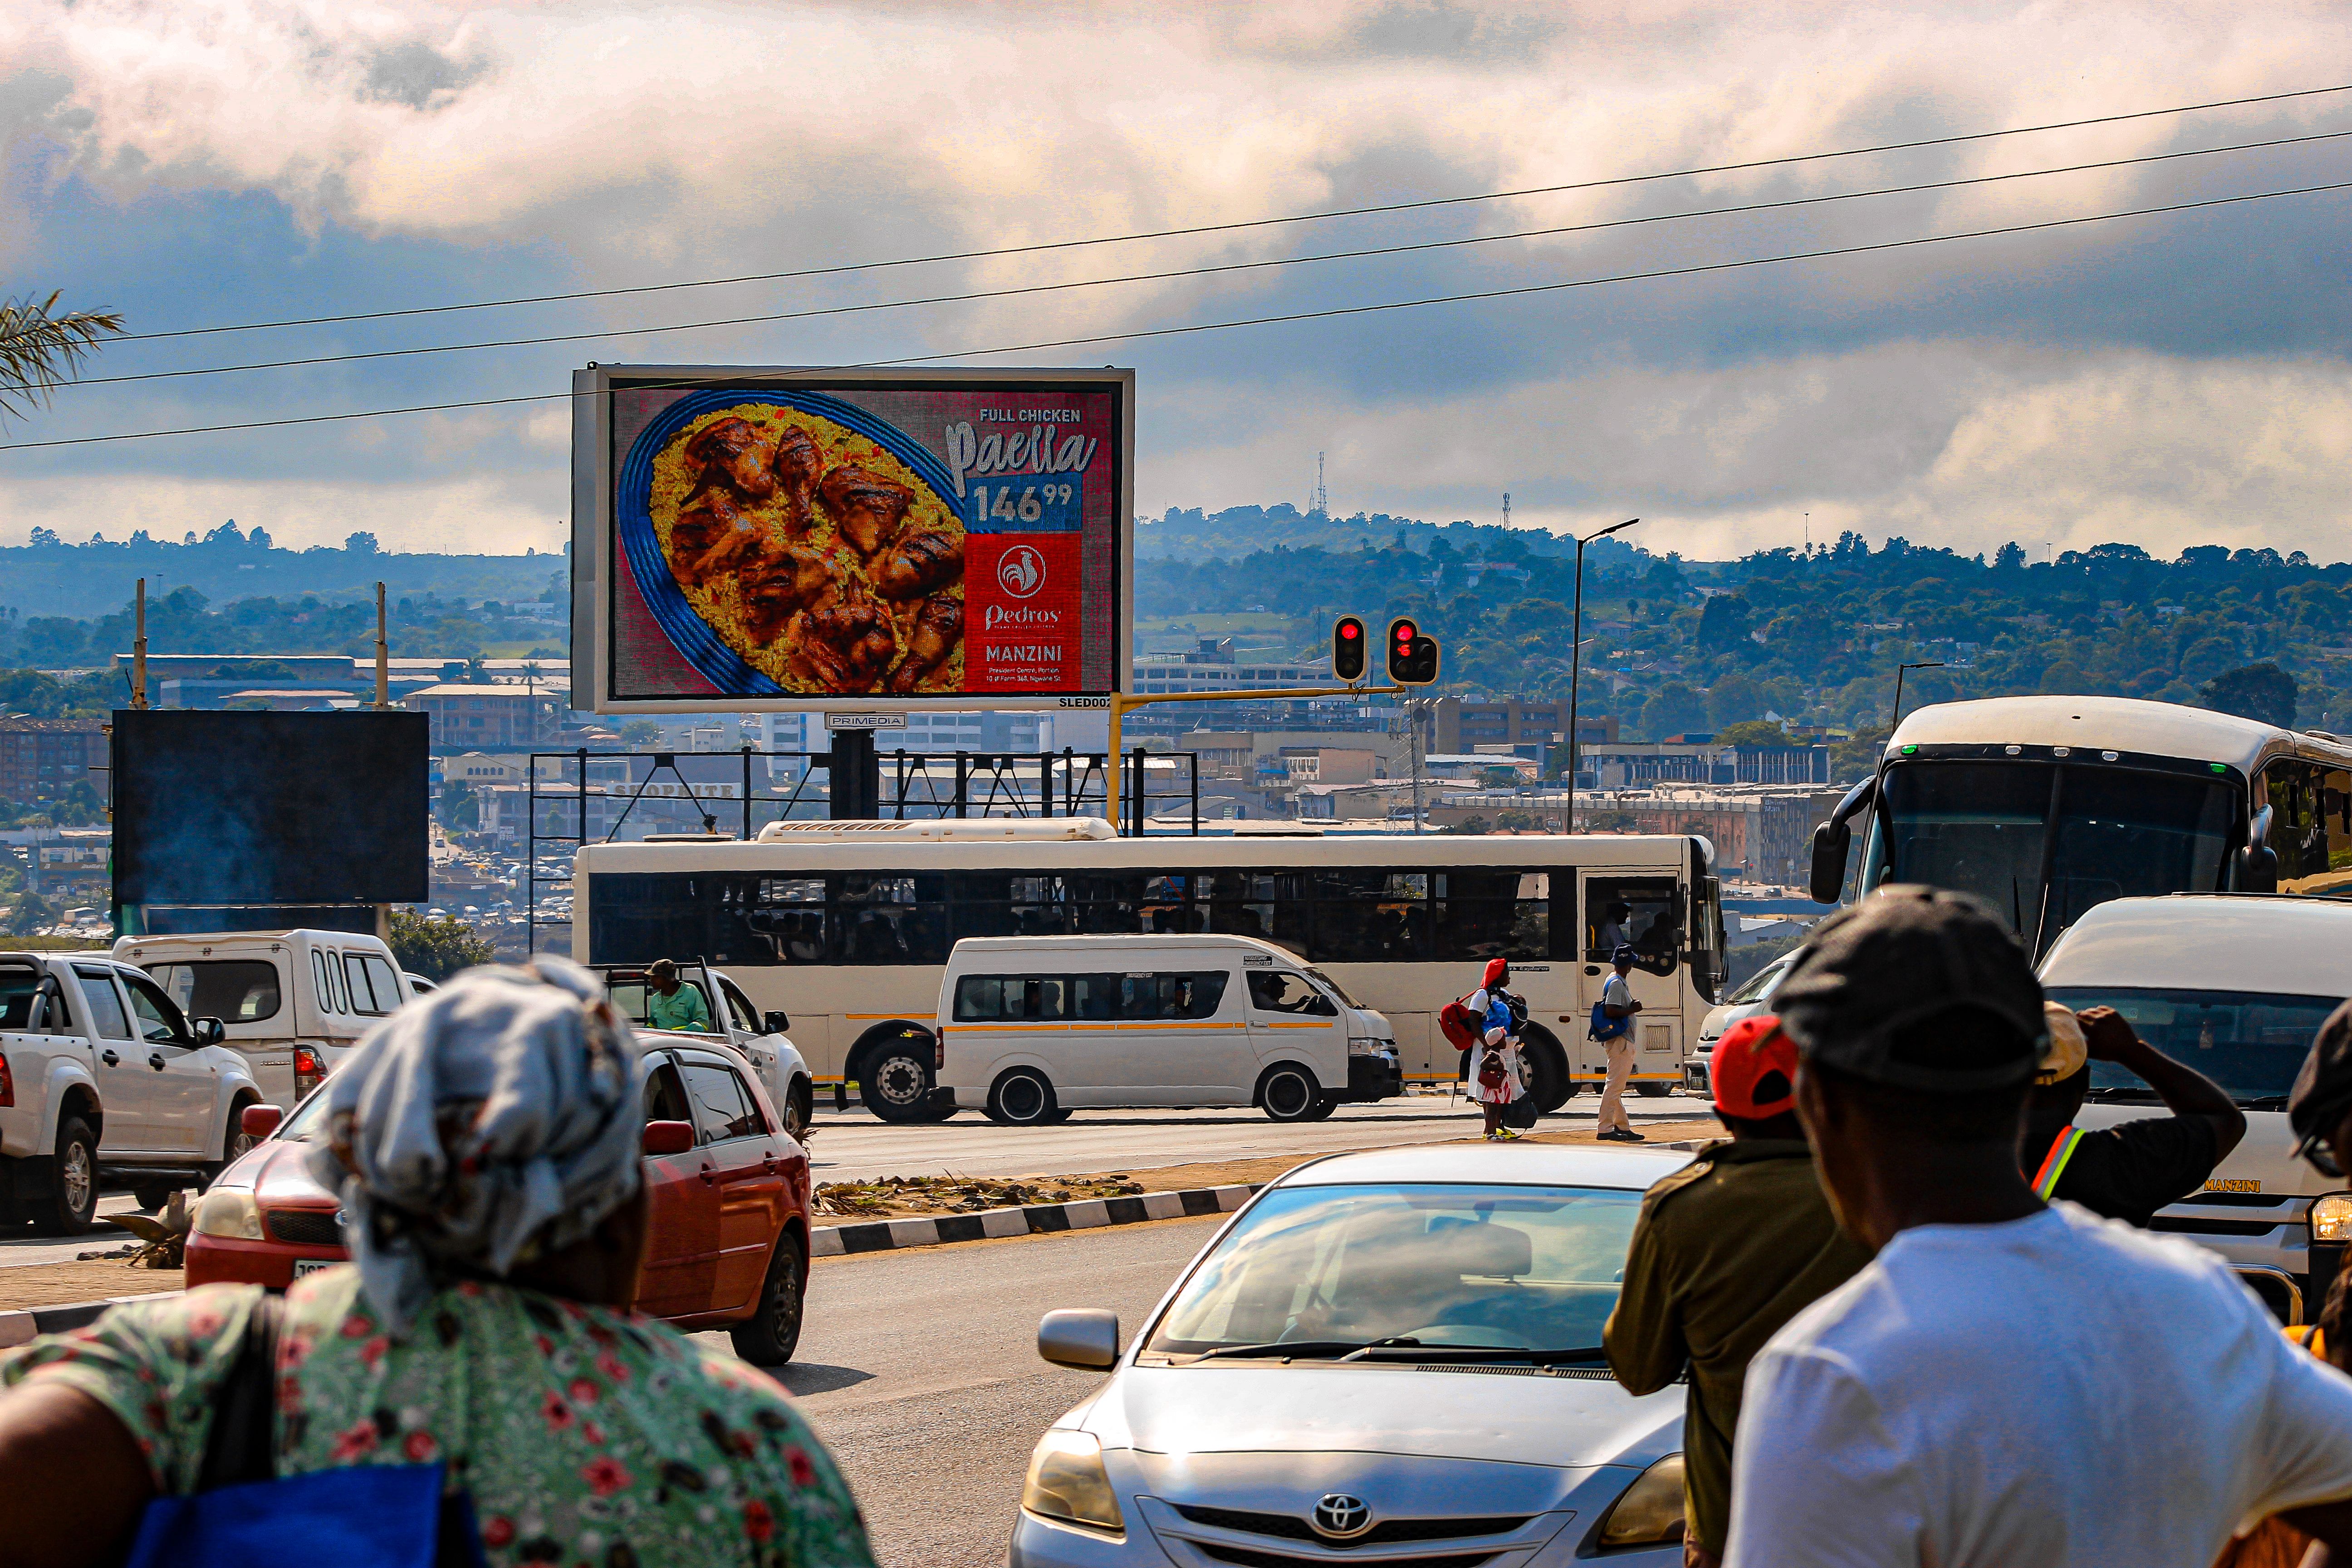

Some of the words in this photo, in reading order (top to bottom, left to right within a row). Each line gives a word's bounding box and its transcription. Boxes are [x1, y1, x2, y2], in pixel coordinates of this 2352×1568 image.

[980, 409, 1015, 421] FULL
[1019, 409, 1080, 422] CHICKEN
[945, 421, 1098, 498] Paella
[985, 605, 1059, 631] Pedros
[986, 646, 1062, 662] MANZINI
[615, 784, 733, 797] SHOPRITE
[2204, 1179, 2261, 1193] MANZINI
